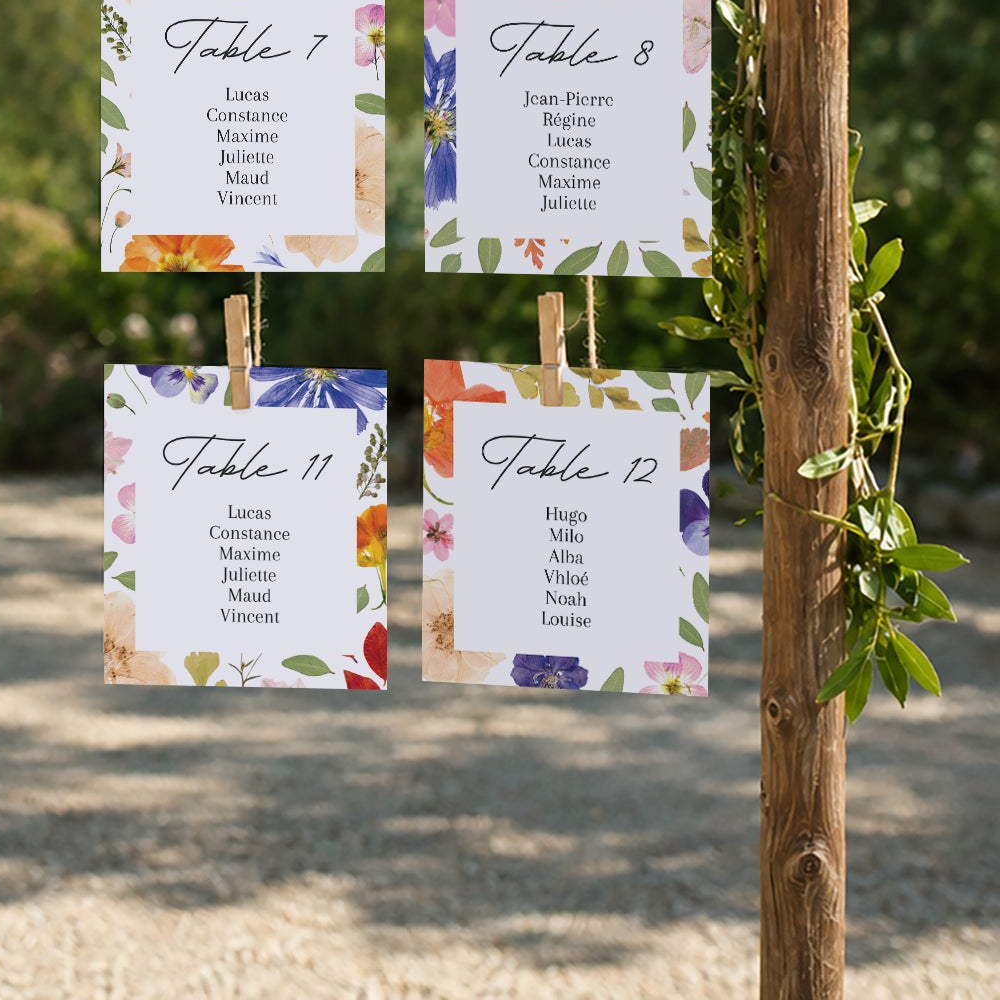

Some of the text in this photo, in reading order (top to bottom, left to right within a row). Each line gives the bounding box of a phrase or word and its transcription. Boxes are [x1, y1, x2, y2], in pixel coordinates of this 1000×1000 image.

[164, 16, 329, 75] Table 7
[489, 19, 655, 78] Table 8
[226, 87, 270, 102] Lucas
[522, 90, 614, 108] Jean-Pierre
[206, 107, 288, 123] Constance
[542, 111, 596, 131] Régine
[217, 128, 279, 144] Maxime
[547, 132, 592, 149] Lucas
[218, 149, 274, 167] Juliette
[528, 152, 611, 170] Constance
[226, 170, 270, 185] Maud
[538, 173, 601, 190] Maxime
[216, 190, 278, 206] Vincent
[540, 194, 597, 213] Juliette
[162, 434, 334, 491] Table 11
[481, 433, 658, 491] Table 12
[228, 504, 272, 520] Lucas
[545, 506, 588, 527] Hugo
[209, 525, 290, 541] Constance
[548, 527, 584, 544] Milo
[219, 546, 281, 562] Maxime
[549, 548, 585, 565] Alba
[220, 566, 277, 585] Juliette
[543, 568, 589, 586] Vhloé
[228, 587, 272, 603] Maud
[545, 590, 587, 607] Noah
[220, 608, 280, 624] Vincent
[541, 610, 592, 629] Louise
